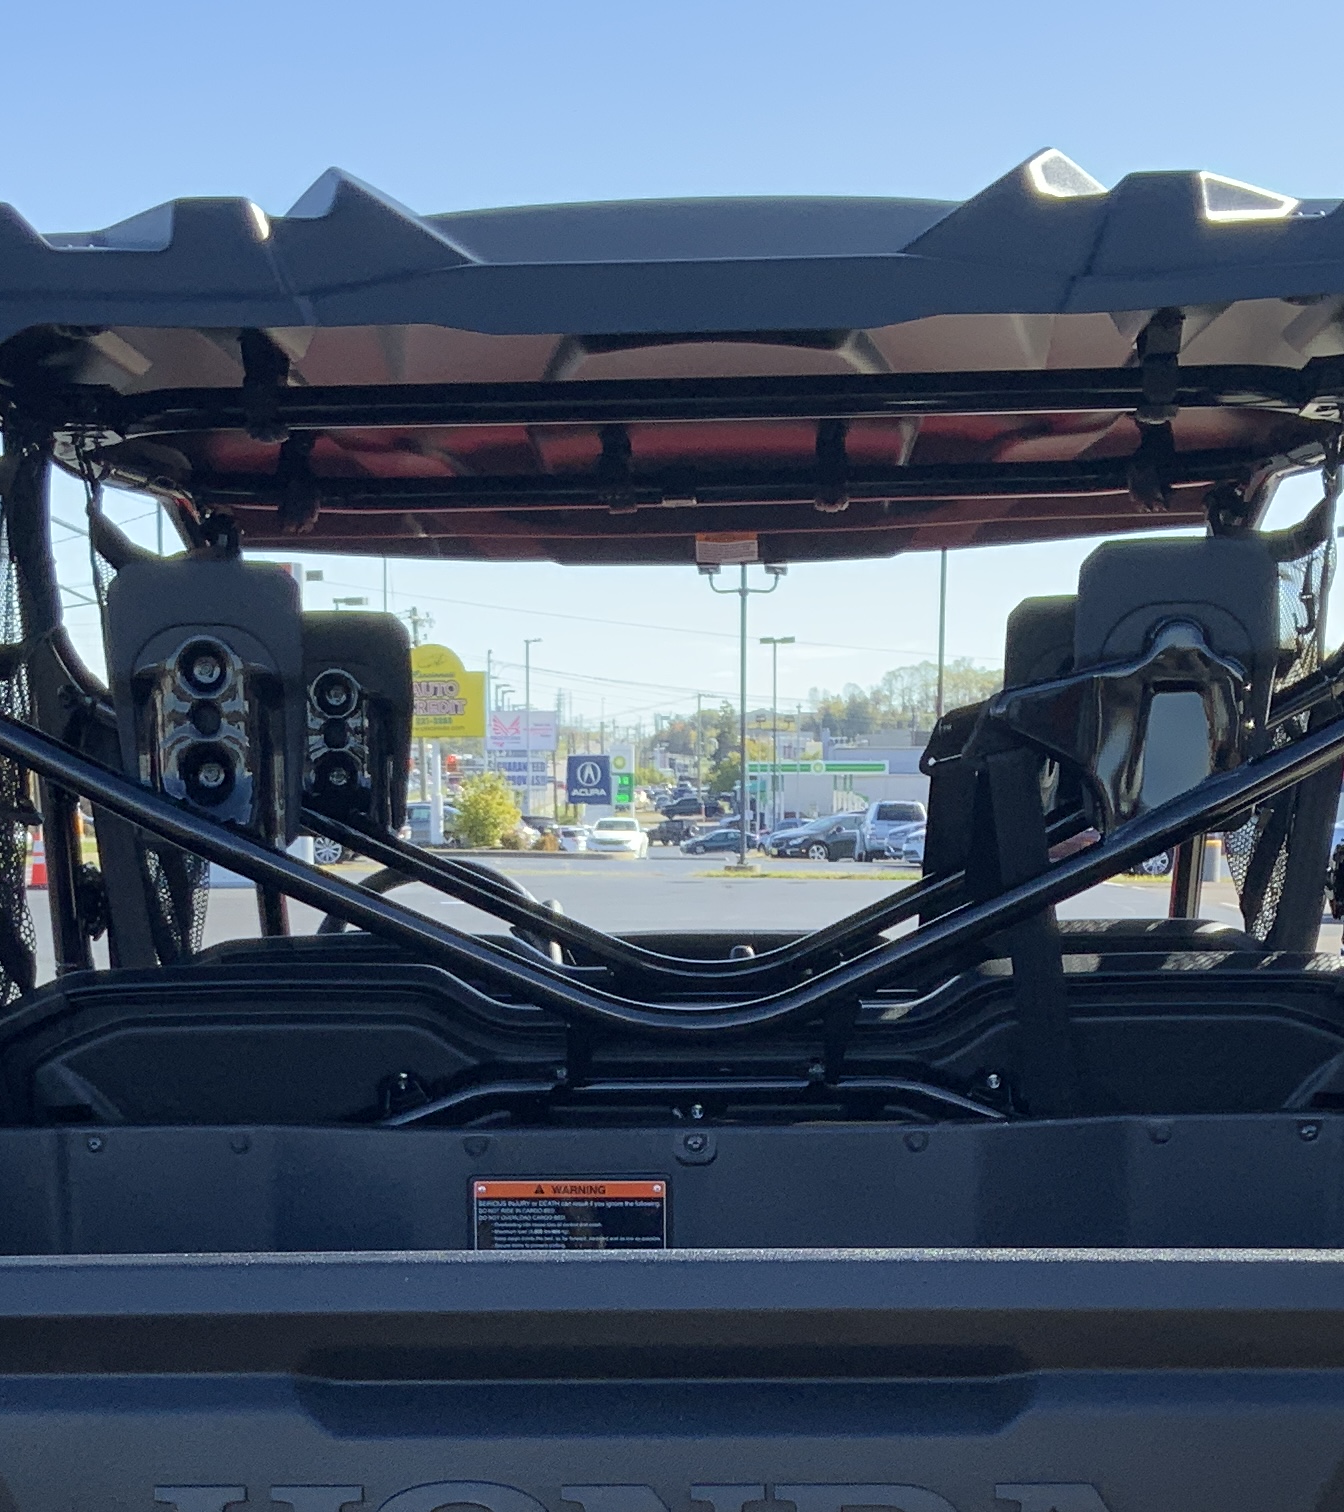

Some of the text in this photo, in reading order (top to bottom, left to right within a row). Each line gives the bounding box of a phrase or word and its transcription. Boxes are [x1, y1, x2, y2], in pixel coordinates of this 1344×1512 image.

[413, 699, 467, 716] REDIT
[571, 788, 606, 797] ACURA
[551, 1185, 606, 1194] WARNING
